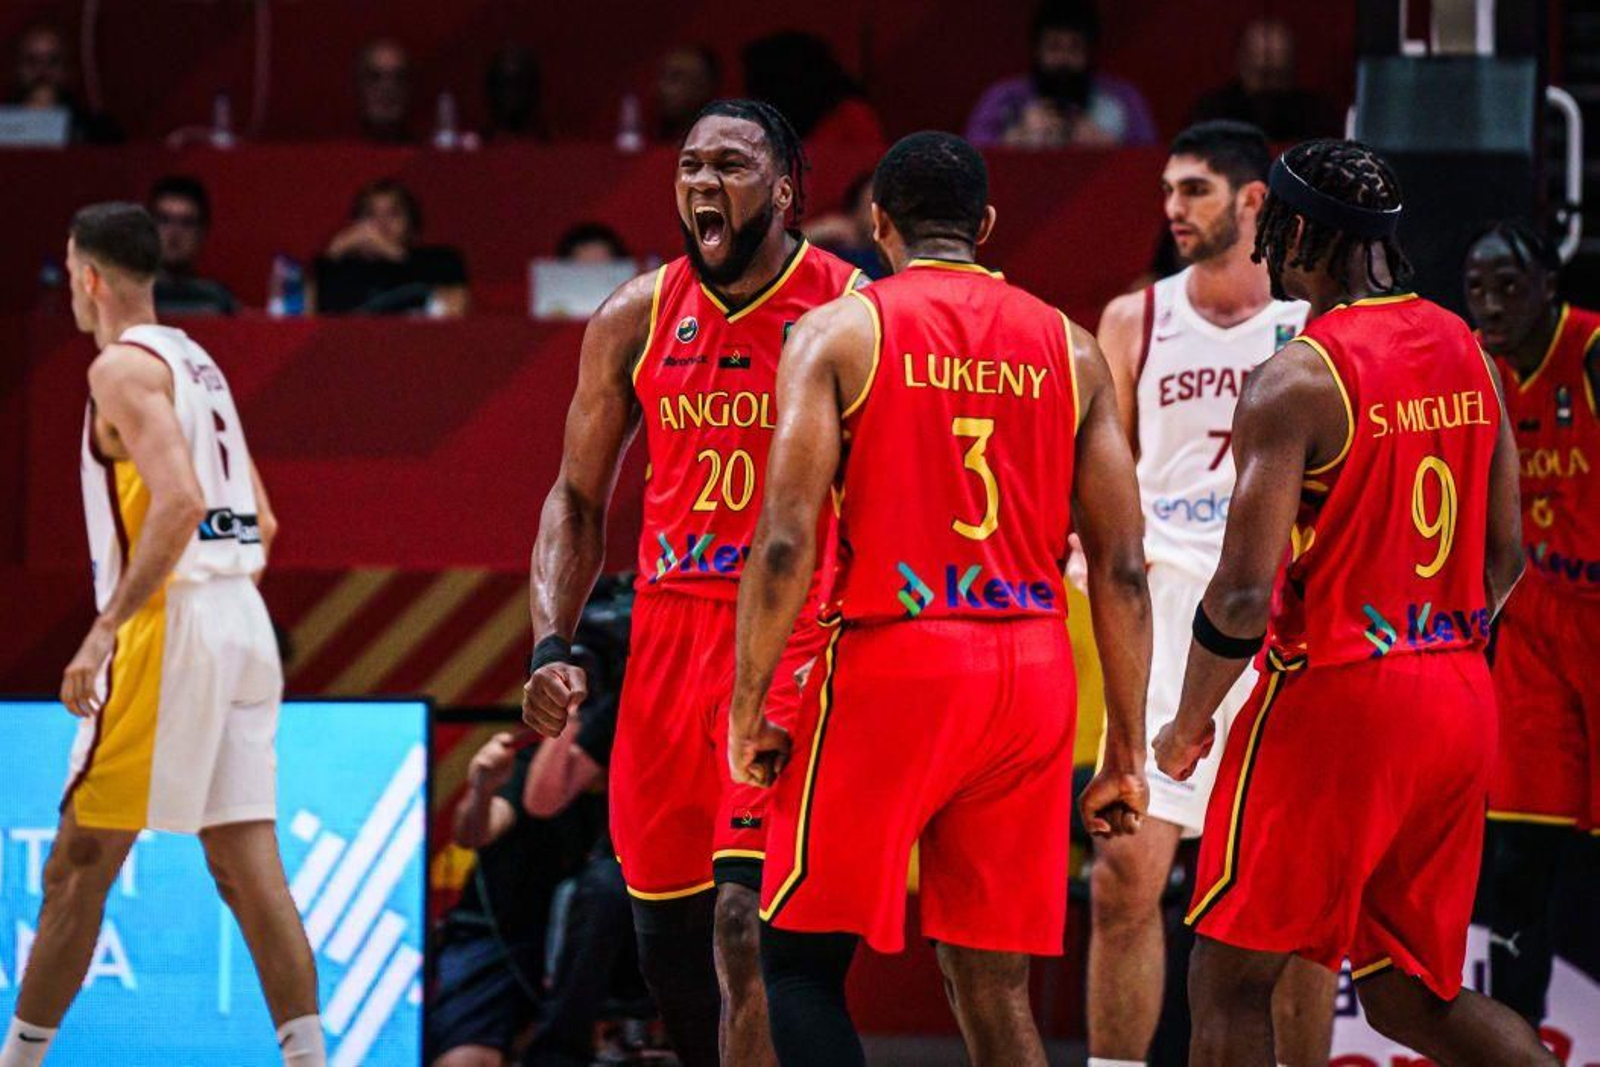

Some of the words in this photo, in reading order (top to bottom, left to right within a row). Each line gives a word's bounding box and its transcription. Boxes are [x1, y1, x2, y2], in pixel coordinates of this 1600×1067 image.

[904, 353, 1048, 399] LUKENY
[1369, 403, 1395, 438] S.
[1396, 391, 1490, 433] MIGUEL
[1207, 430, 1233, 471] 7
[692, 449, 755, 512] 20
[951, 417, 999, 541] 3
[1412, 456, 1458, 578] 9
[944, 564, 1056, 611] Keve
